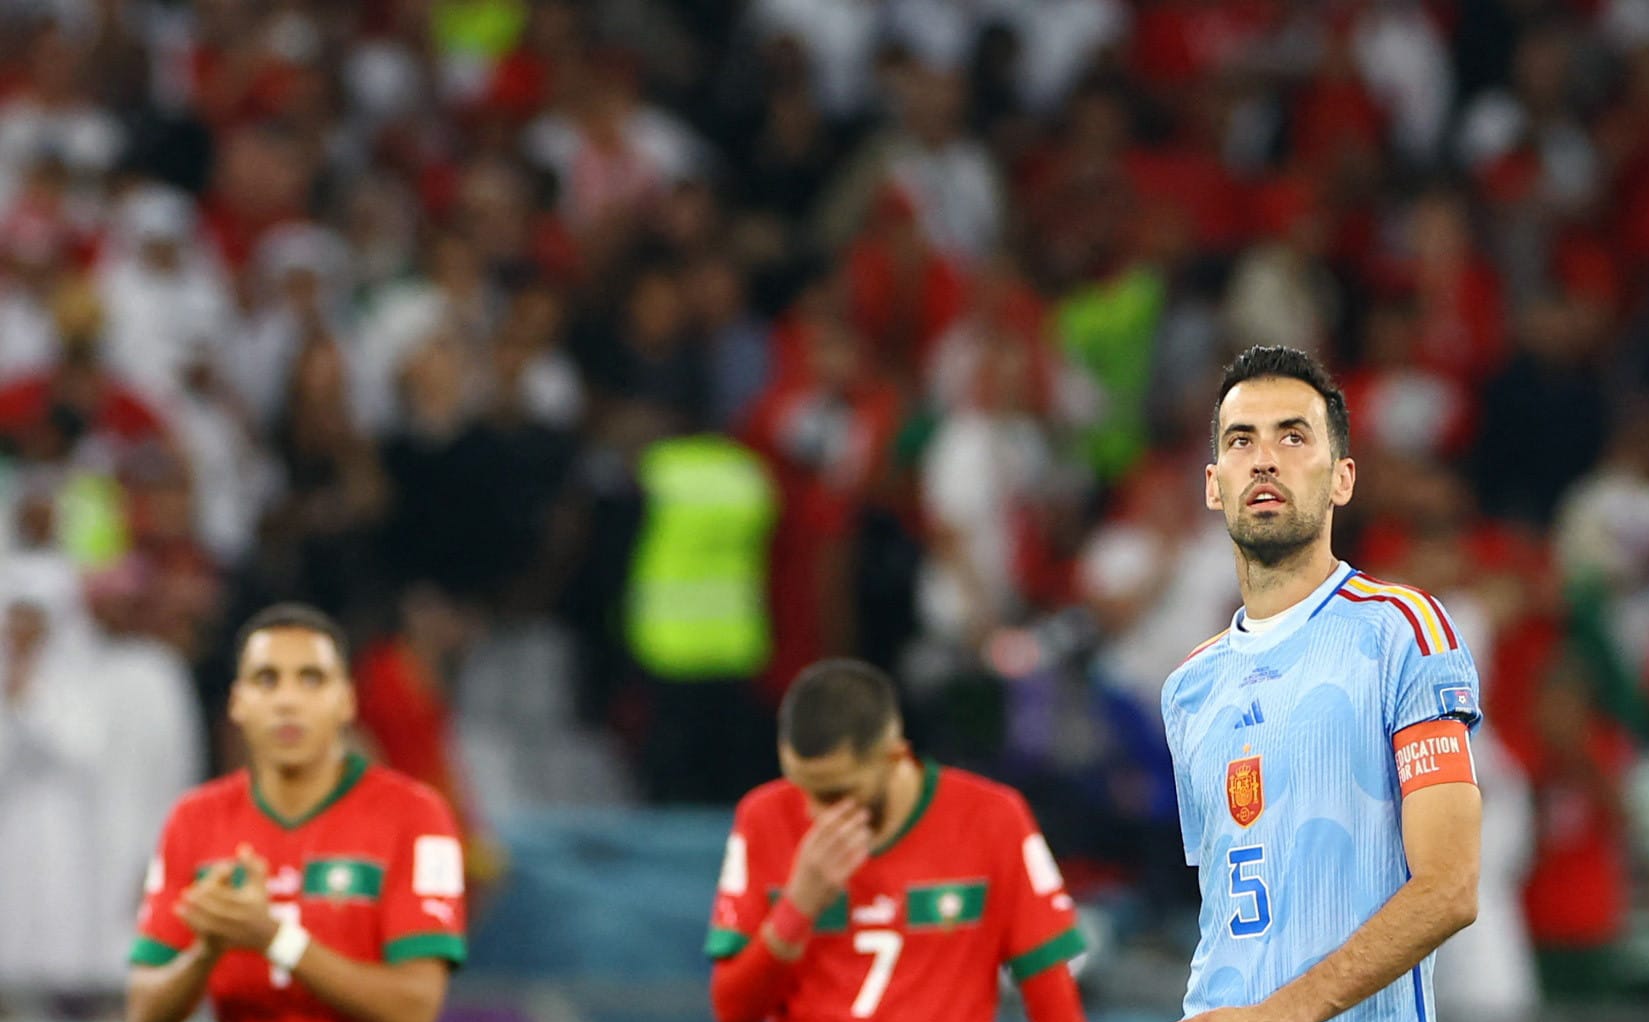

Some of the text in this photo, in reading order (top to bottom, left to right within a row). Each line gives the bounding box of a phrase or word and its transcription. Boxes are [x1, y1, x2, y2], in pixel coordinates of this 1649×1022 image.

[1415, 756, 1440, 776] ALL
[1226, 843, 1273, 939] 5
[851, 930, 903, 1018] 7
